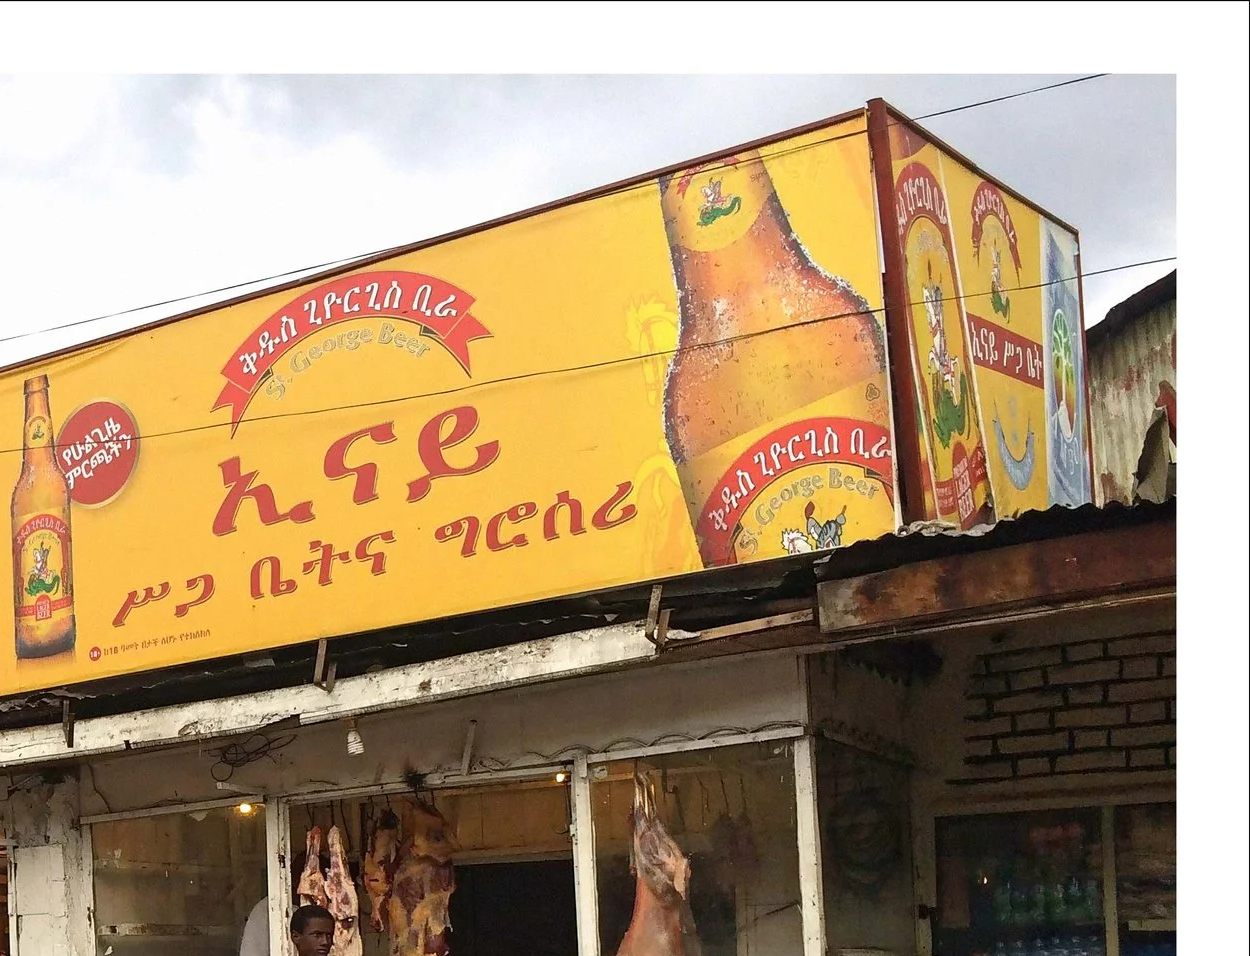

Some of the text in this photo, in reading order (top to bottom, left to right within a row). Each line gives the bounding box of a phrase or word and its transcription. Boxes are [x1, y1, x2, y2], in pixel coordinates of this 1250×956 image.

[239, 280, 459, 376] ቅዱስ ጊዮርጊስ ቢራ
[289, 324, 374, 374] George
[378, 322, 431, 358] Beer
[212, 406, 502, 537] ኢናይ
[708, 426, 892, 532] ቅዱስ ጊዮርጊስ ቢራ
[754, 473, 824, 526] George
[828, 467, 881, 500] Beer
[111, 480, 638, 629] ሥጋ ቤትና ግሮሰሪ
